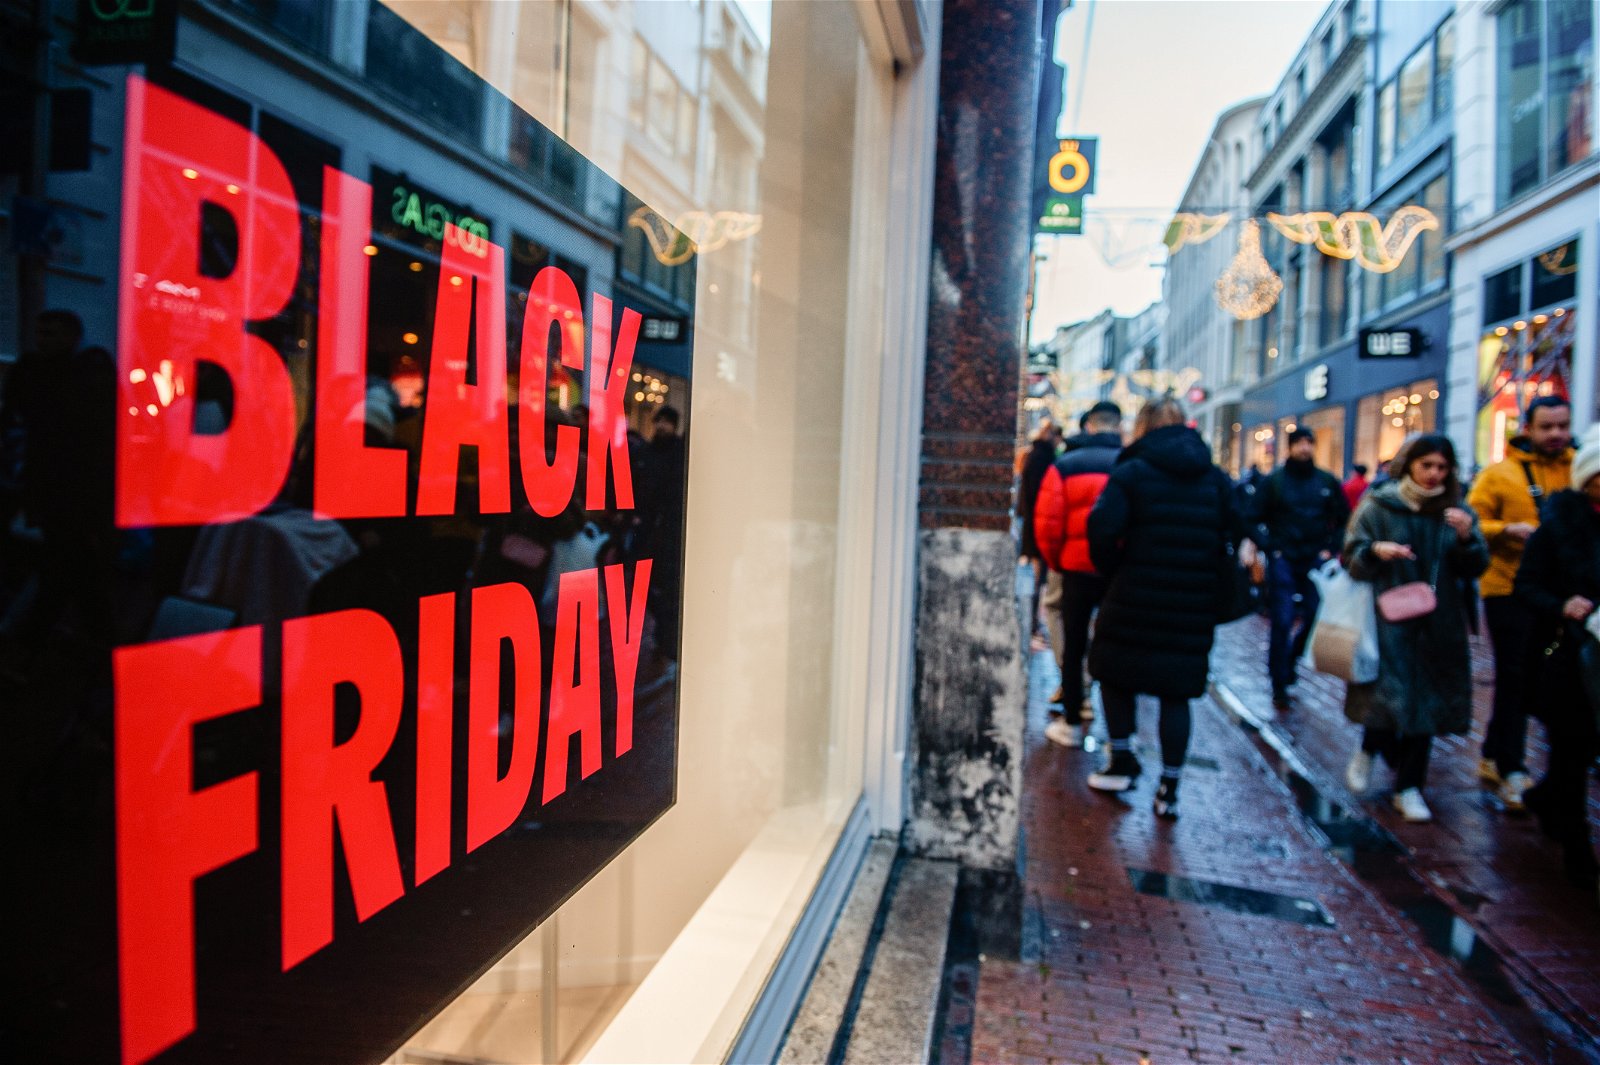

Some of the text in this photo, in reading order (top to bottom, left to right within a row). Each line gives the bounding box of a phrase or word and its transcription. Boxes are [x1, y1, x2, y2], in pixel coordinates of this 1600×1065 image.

[115, 73, 642, 529] BLACK
[1367, 332, 1411, 355] WE
[112, 558, 654, 1065] FRIDAY
